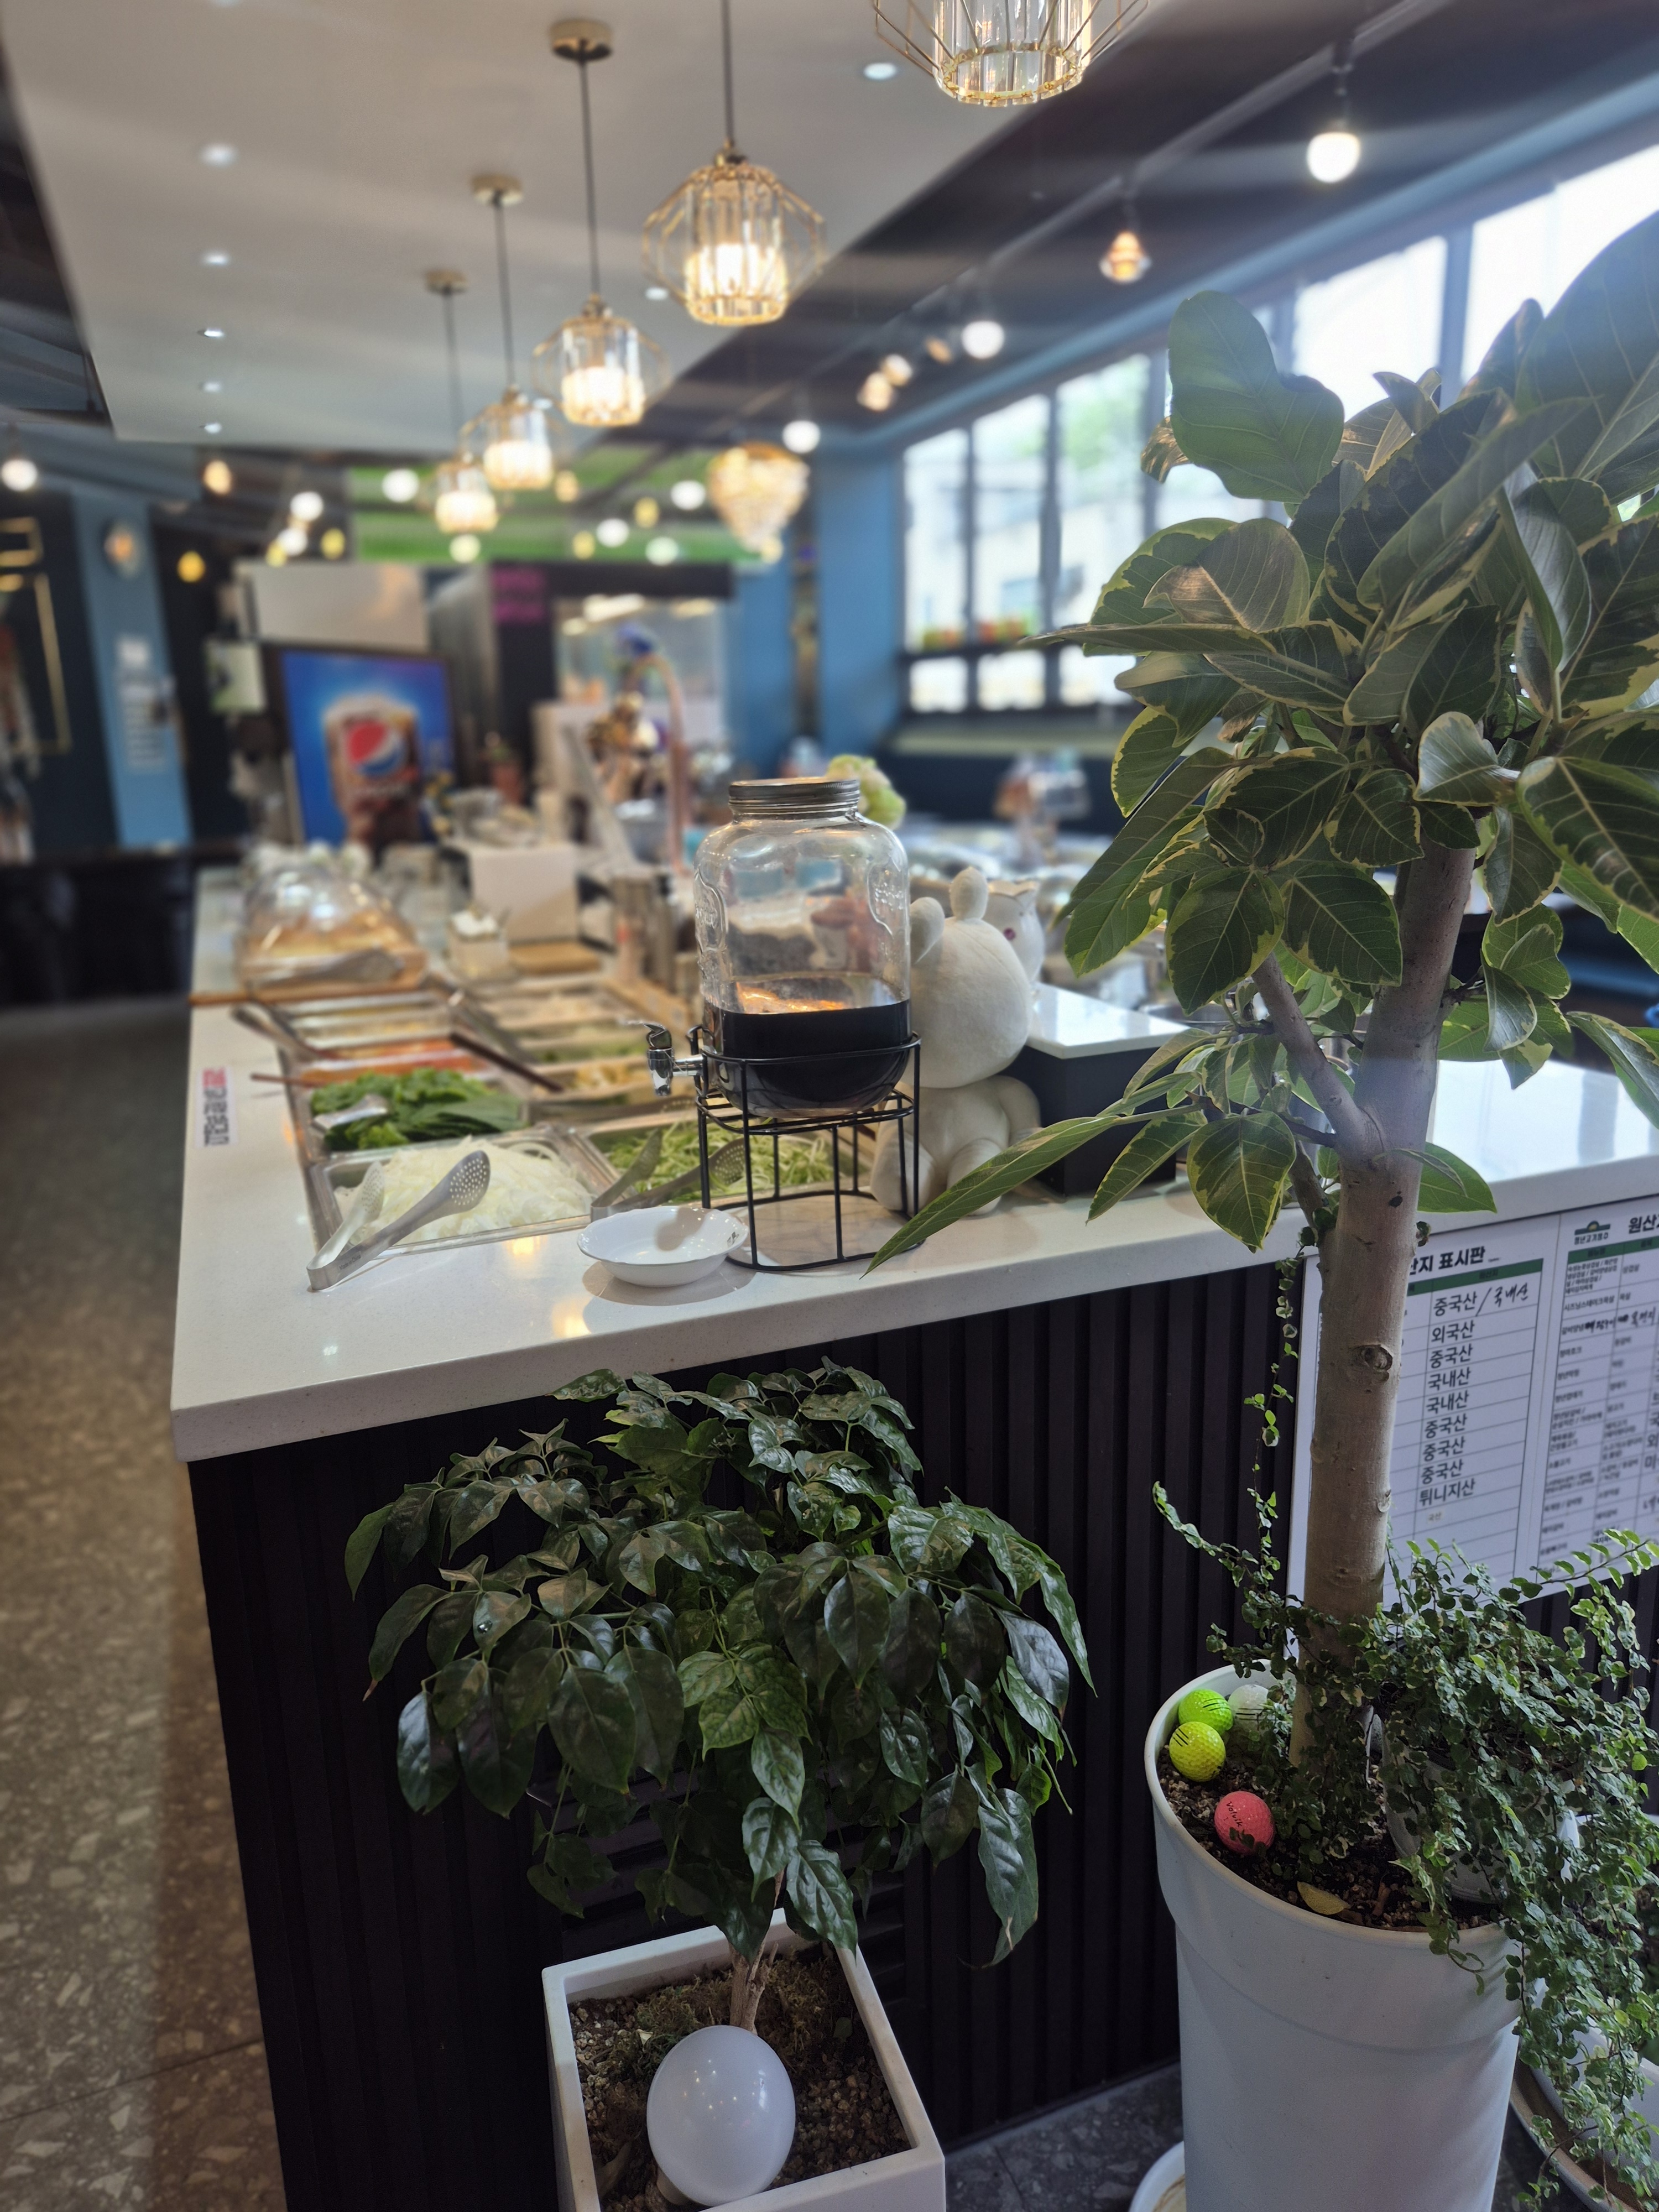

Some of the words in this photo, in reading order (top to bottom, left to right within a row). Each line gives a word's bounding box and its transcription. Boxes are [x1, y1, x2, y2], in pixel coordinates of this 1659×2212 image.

[1629, 1214, 1659, 1234] 원산
[1438, 1246, 1485, 1270] 표시판
[1433, 1291, 1477, 1317] 중국산
[1494, 1282, 1528, 1307] 국내산
[1431, 1320, 1475, 1343] 외국산
[1430, 1343, 1473, 1369] 중국산
[1428, 1367, 1471, 1391] 국내산
[1426, 1390, 1469, 1414] 국내산
[1425, 1413, 1468, 1439] 중국산
[1422, 1436, 1465, 1462] 중국산
[1421, 1458, 1463, 1485] 중국산
[1419, 1478, 1476, 1506] 튀니지산
[1226, 1801, 1243, 1827] Volvik
